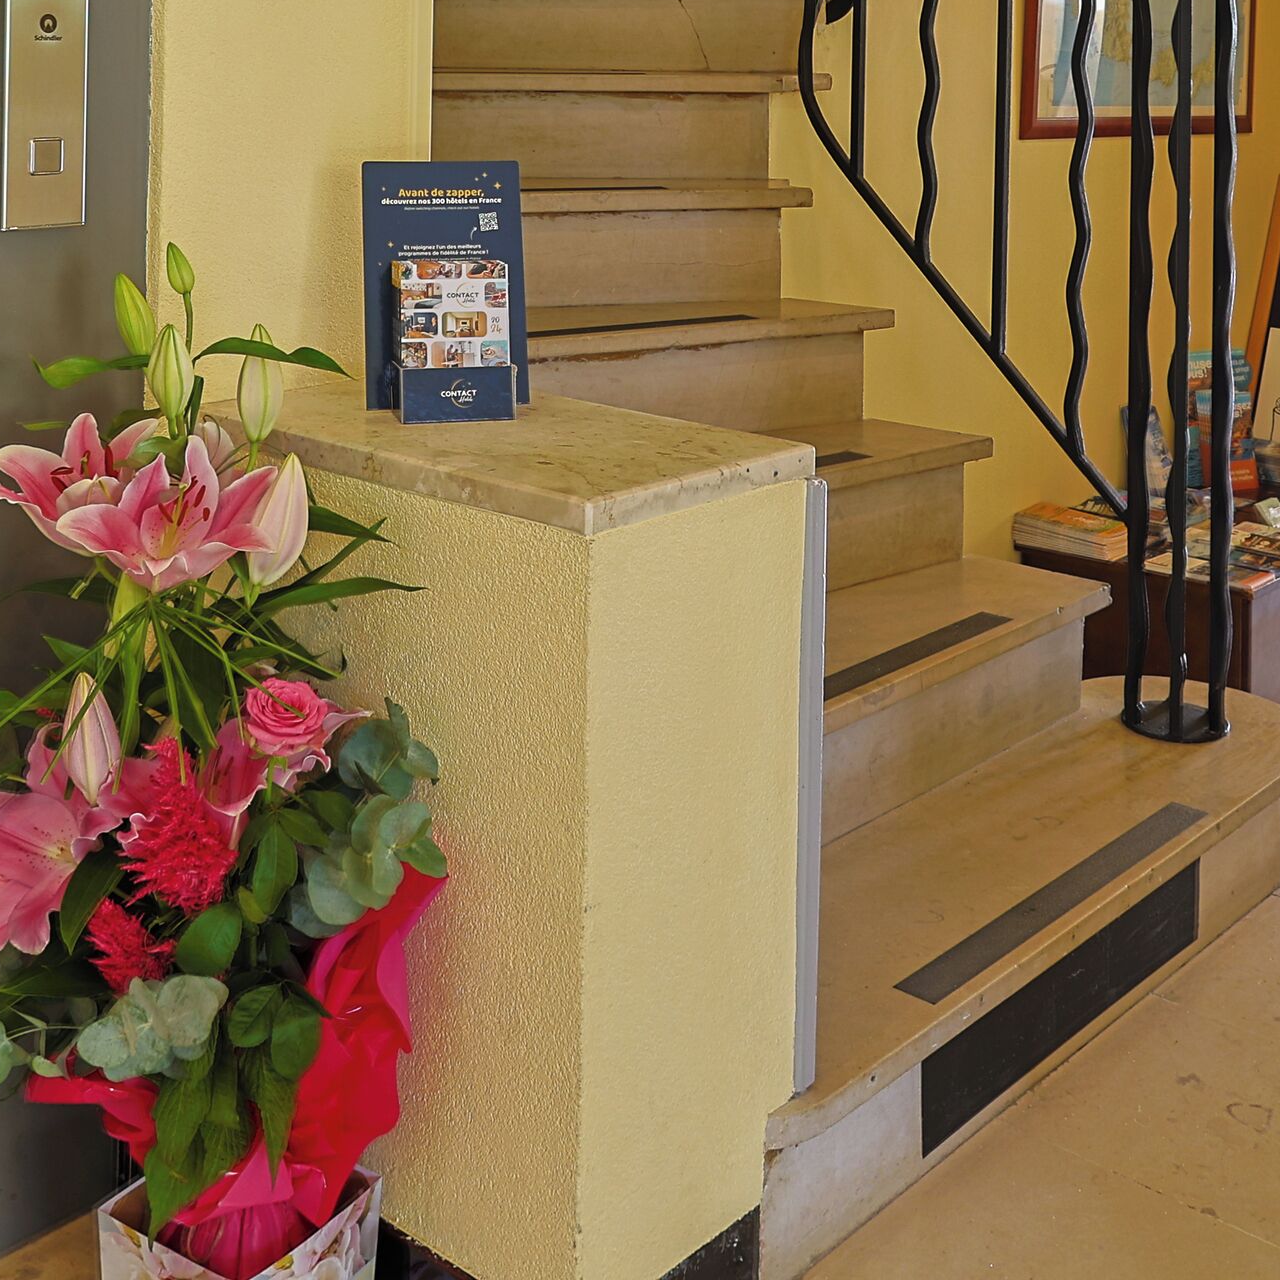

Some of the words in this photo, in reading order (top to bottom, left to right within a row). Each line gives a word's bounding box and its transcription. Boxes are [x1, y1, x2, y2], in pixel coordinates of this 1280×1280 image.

[34, 34, 63, 42] Schindler
[398, 188, 429, 197] Avant
[431, 188, 444, 197] de
[446, 188, 484, 199] zapper,
